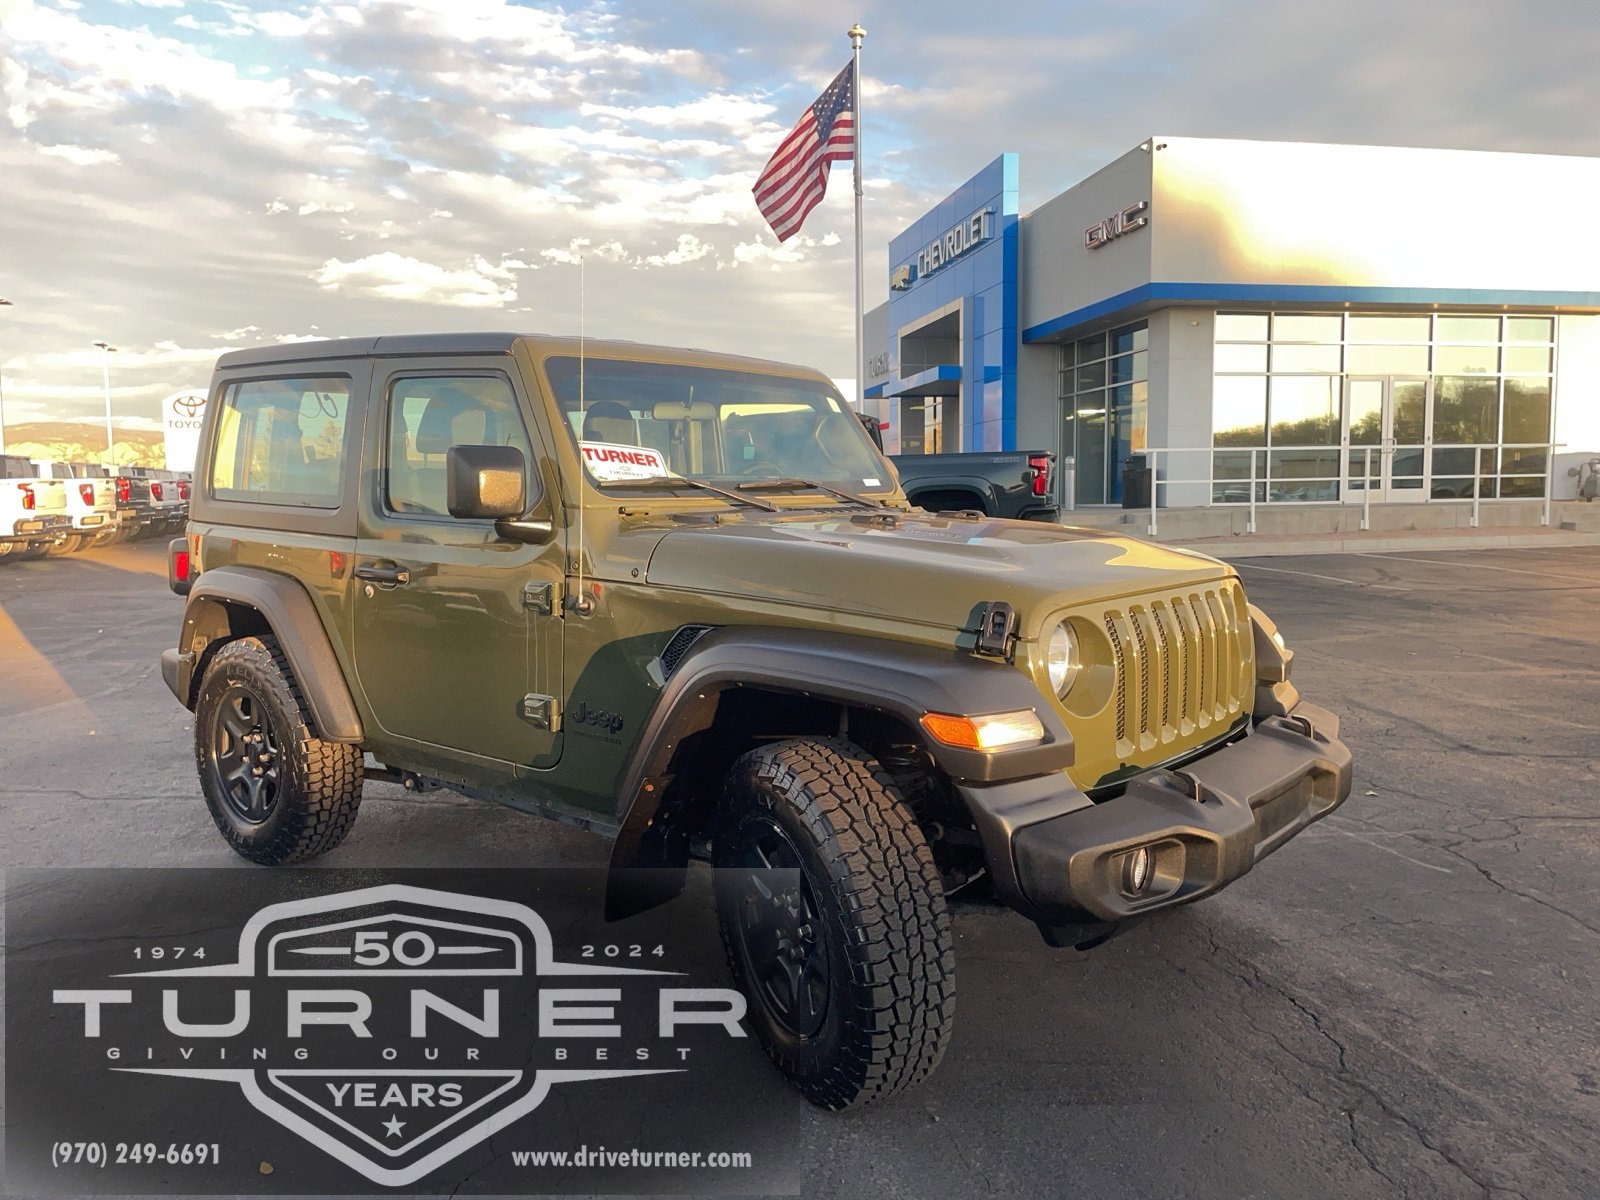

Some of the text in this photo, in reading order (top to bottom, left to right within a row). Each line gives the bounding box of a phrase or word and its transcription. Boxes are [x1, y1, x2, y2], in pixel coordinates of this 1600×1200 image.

[917, 206, 995, 279] CHEVROLET
[1085, 201, 1148, 249] GMC
[582, 447, 660, 468] TURNER
[572, 702, 624, 734] Jeep
